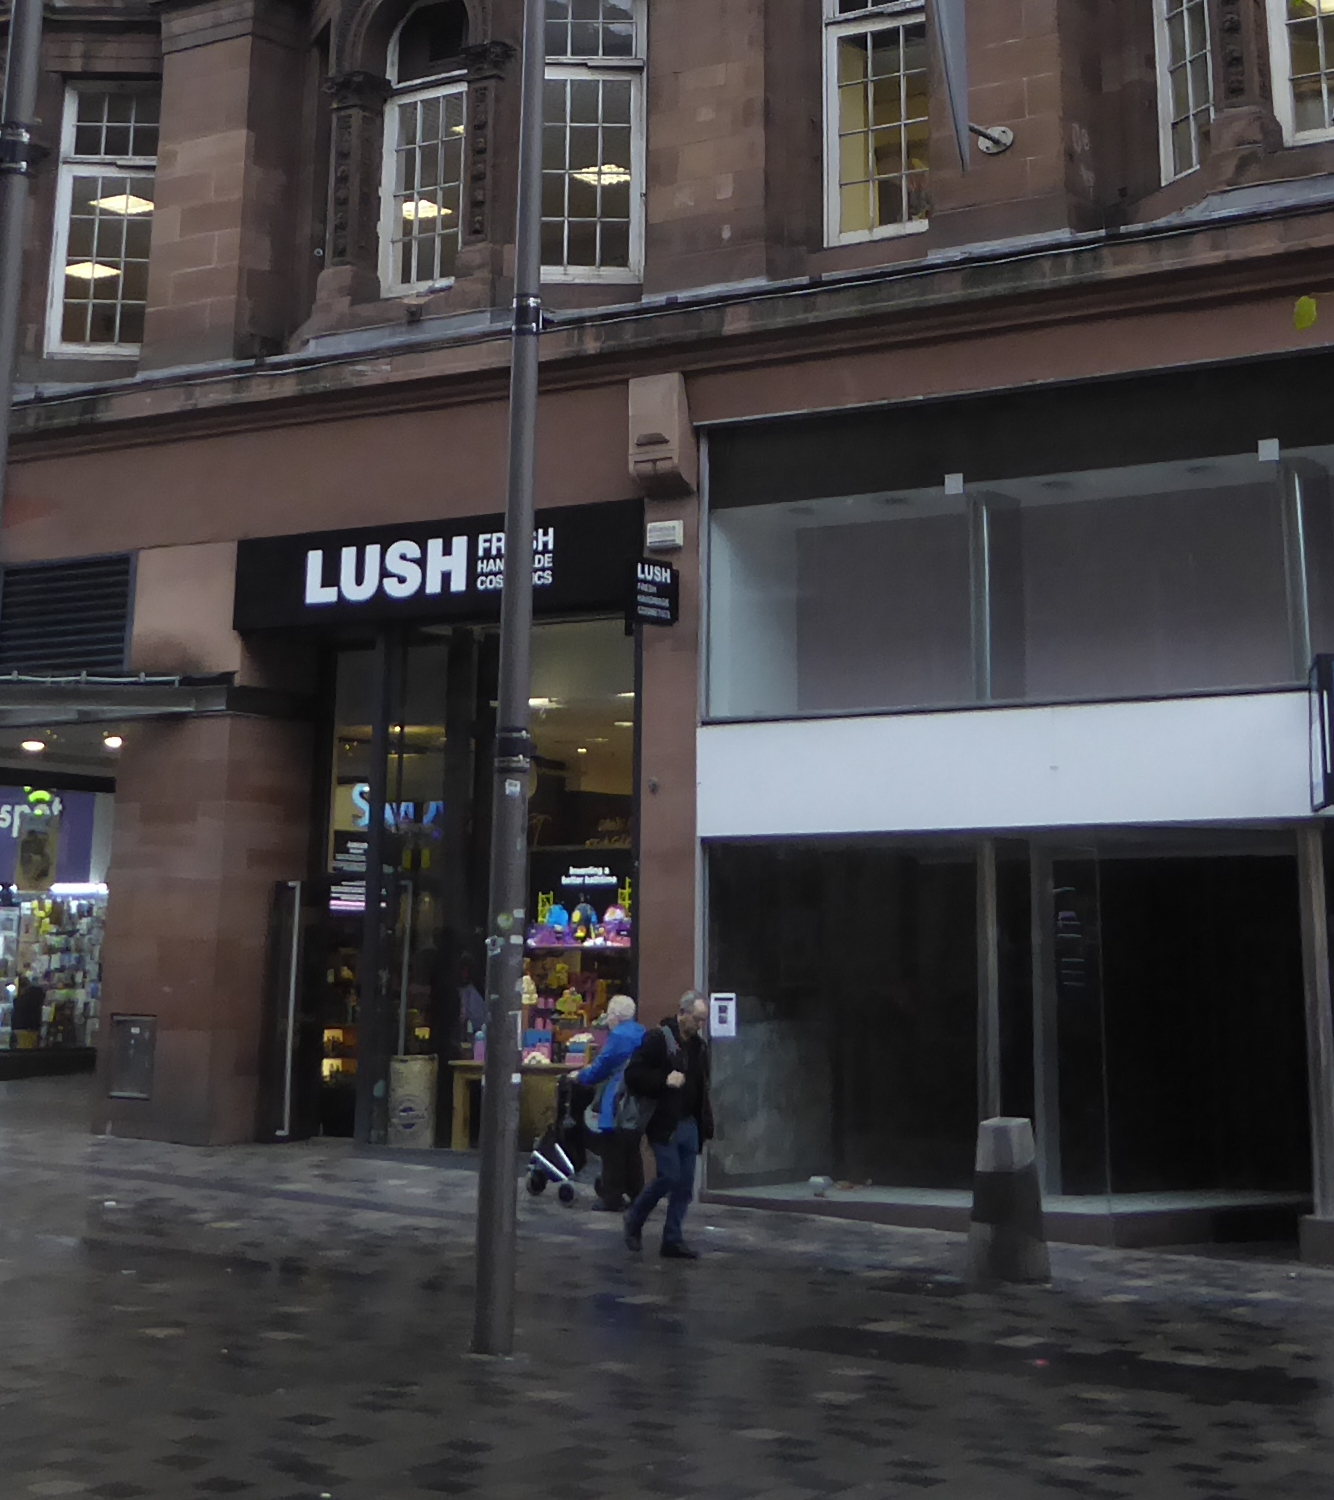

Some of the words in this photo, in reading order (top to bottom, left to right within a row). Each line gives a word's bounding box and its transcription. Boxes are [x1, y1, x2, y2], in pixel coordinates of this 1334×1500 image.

[478, 527, 554, 557] FRH
[305, 535, 468, 604] LUSH
[477, 553, 553, 574] HANDE
[637, 562, 671, 584] LUSH
